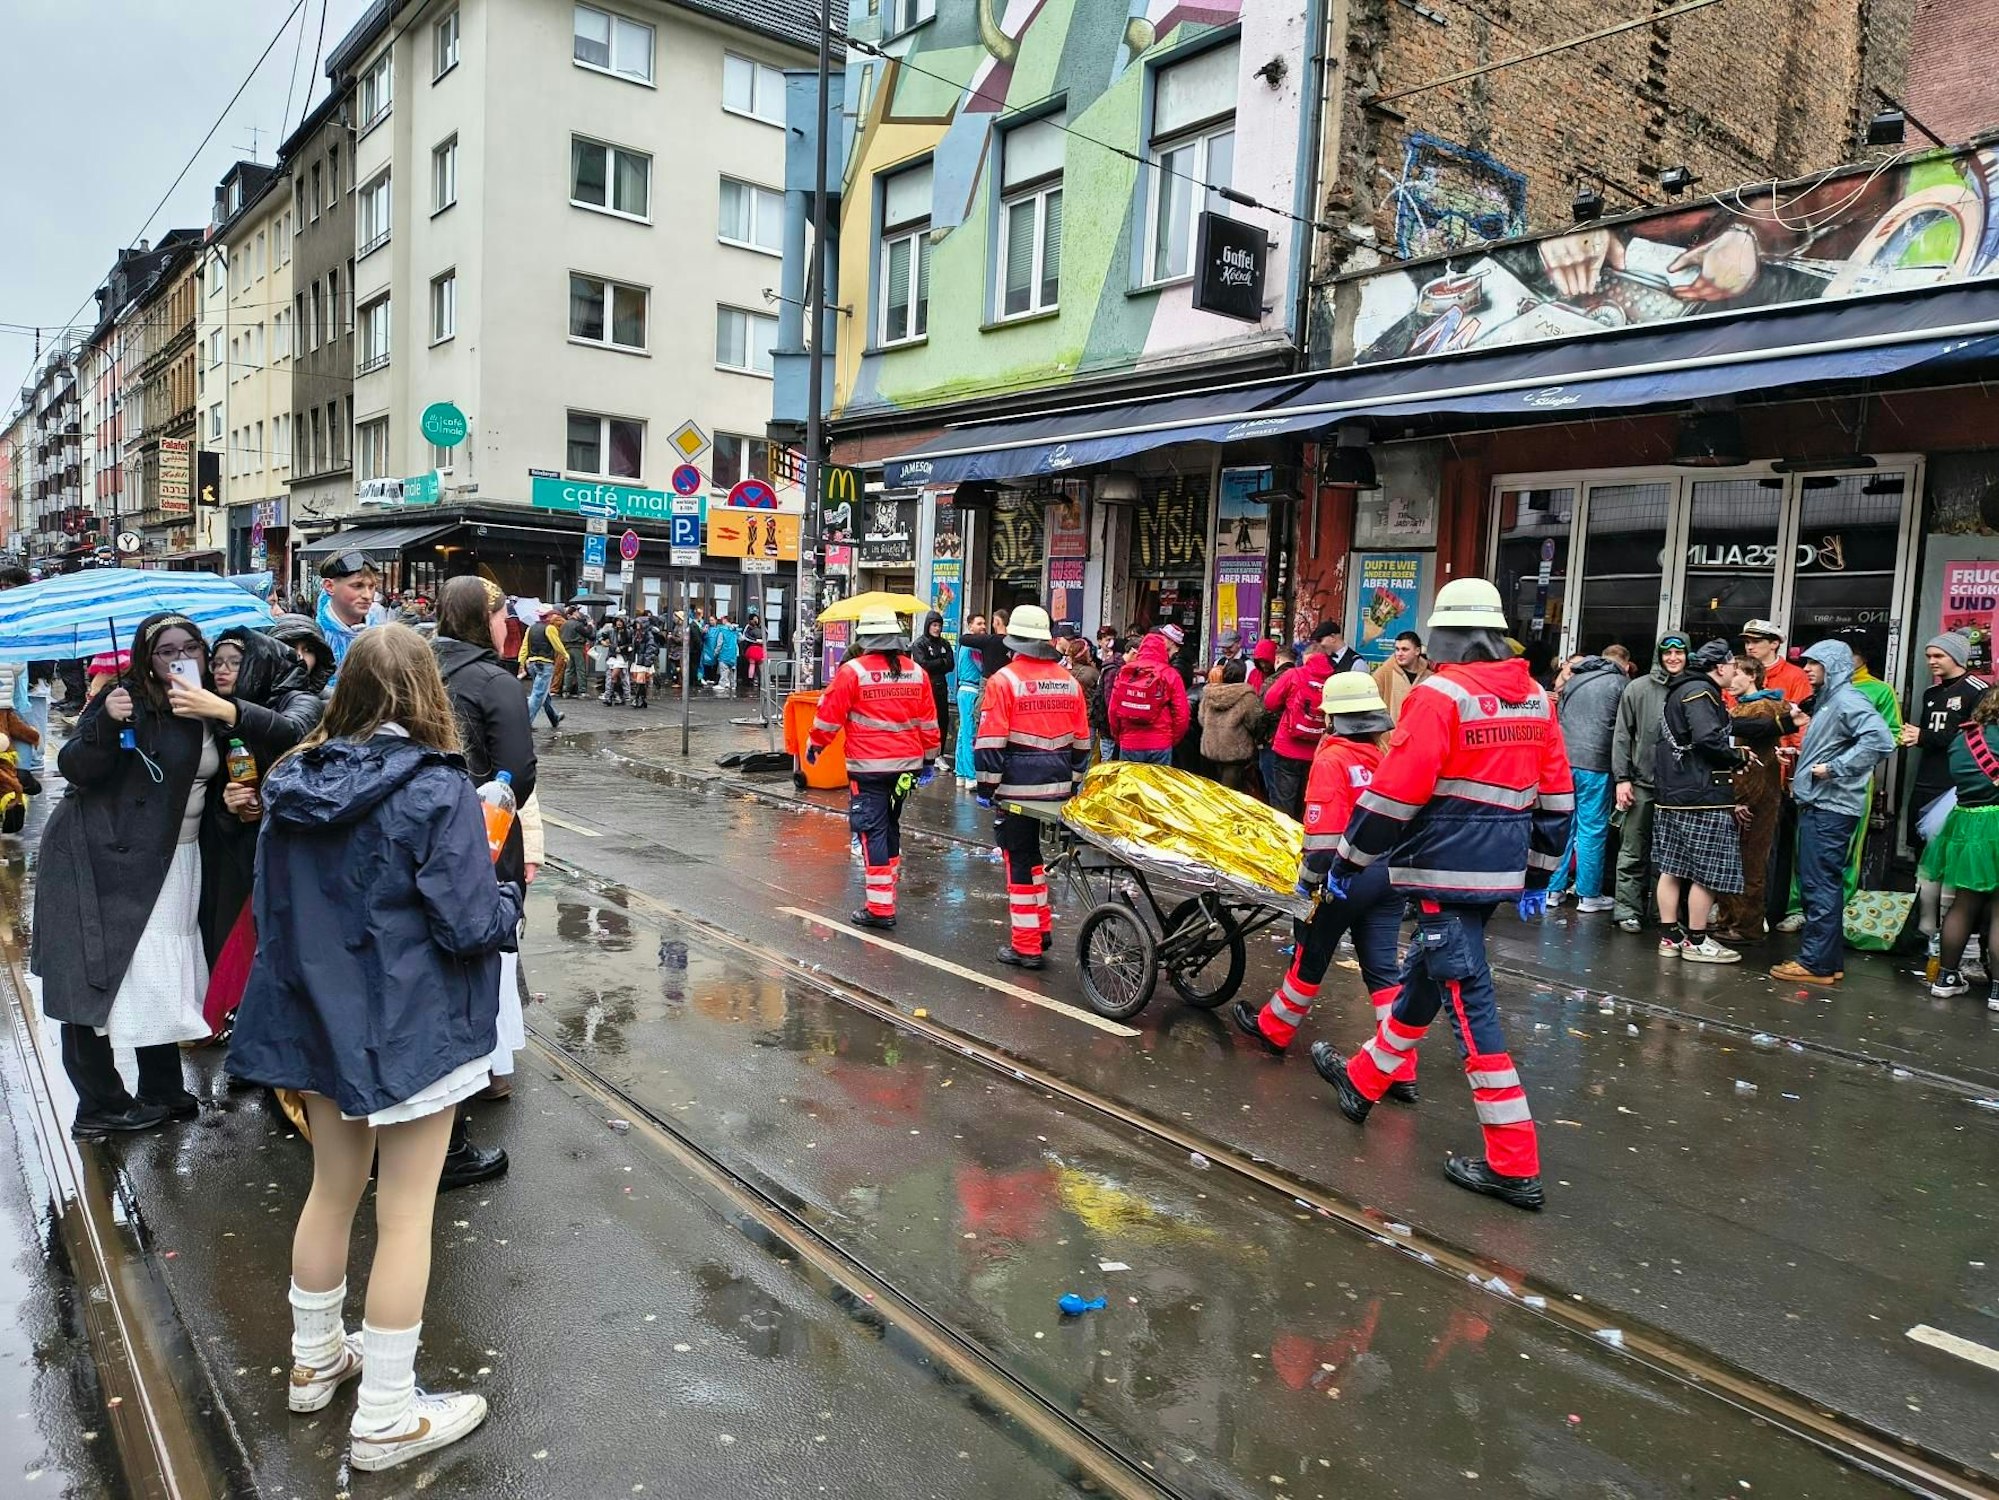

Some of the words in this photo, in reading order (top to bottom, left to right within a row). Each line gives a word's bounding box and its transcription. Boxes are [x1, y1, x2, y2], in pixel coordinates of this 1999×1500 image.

[1223, 245, 1254, 271] Gaffel
[443, 419, 463, 427] café
[162, 440, 188, 451] Falafel
[900, 461, 933, 478] JAMESON
[563, 485, 618, 506] café
[627, 490, 672, 512] mal
[676, 519, 691, 543] P
[588, 538, 598, 549] P
[1364, 560, 1396, 570] DUFTE
[1397, 560, 1417, 570] WIE
[1219, 574, 1240, 583] ABER
[1241, 574, 1262, 584] FAIR.
[1363, 570, 1390, 578] ANDERE
[1391, 570, 1417, 578] ROSEN.
[1050, 579, 1065, 589] UND
[1066, 580, 1083, 589] FAIR.
[1362, 578, 1389, 588] ABER
[1391, 578, 1416, 589] FAIR.
[1950, 596, 1996, 610] UND
[1038, 681, 1069, 690] Malteser
[863, 686, 920, 699] RETTUNGSDIENST
